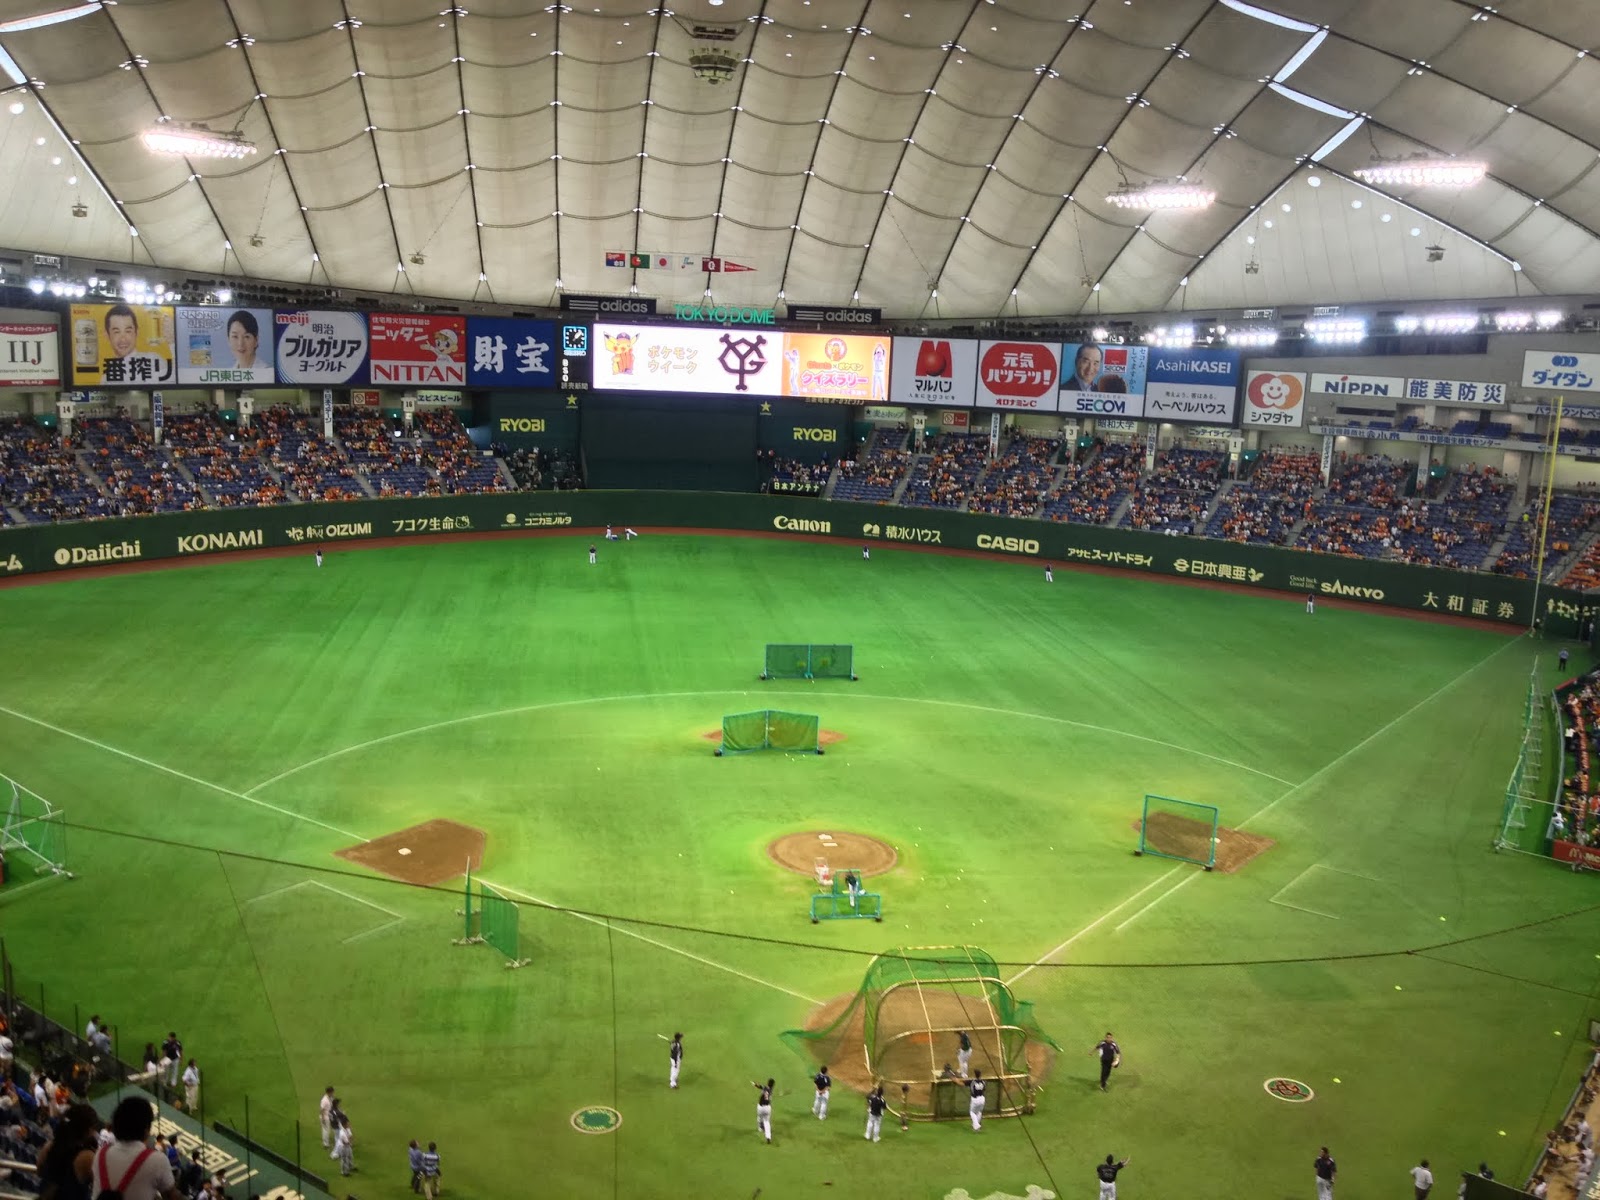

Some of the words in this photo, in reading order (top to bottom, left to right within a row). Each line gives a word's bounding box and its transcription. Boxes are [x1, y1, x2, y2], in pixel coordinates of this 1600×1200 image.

[600, 299, 648, 313] adidas
[276, 311, 309, 326] meiji
[673, 303, 728, 321] TOKYO
[729, 308, 776, 325] DOME
[825, 309, 873, 323] adidas
[312, 323, 335, 335] 明治
[371, 325, 429, 342] ニッタン
[7, 340, 43, 365] IIJ
[285, 335, 362, 358] ブルガリア
[473, 335, 550, 373] 財宝
[648, 346, 698, 359] ポケモン
[299, 359, 347, 372] ヨーグルト
[1003, 352, 1034, 368] 元気
[1156, 359, 1231, 374] AsahiKASEI
[76, 356, 173, 381] 一番搾り
[200, 370, 254, 382] JR東日本
[374, 364, 464, 382] NITTAN
[915, 379, 953, 393] マルハン
[1532, 369, 1593, 388] ダイダン
[1409, 380, 1502, 403] 能美防災
[62, 405, 71, 414] 14
[243, 401, 249, 409] 4
[995, 398, 1037, 407] オロナミンC
[1076, 398, 1126, 414] SECOM
[1152, 400, 1226, 414] ヘーベルハウス
[500, 418, 545, 432] RYOBI
[1097, 419, 1135, 430] 昭和大学
[1251, 411, 1294, 424] シマダヤ
[793, 427, 837, 442] RYOBI
[1068, 428, 1074, 436] 3
[774, 481, 820, 492] 日本アンテナ
[392, 516, 454, 532] フコク生命
[524, 516, 572, 526] コニカミノルタ
[773, 515, 831, 533] Canon
[326, 522, 372, 537] OIZUMI
[886, 525, 942, 544] 積水ハウス
[177, 528, 263, 552] KONAMI
[976, 534, 1040, 554] CASIO
[72, 539, 141, 564] Daiichi
[1191, 560, 1247, 581] 日本興亜
[1320, 578, 1384, 600] SANKYO
[1422, 591, 1514, 619] 大和証券
